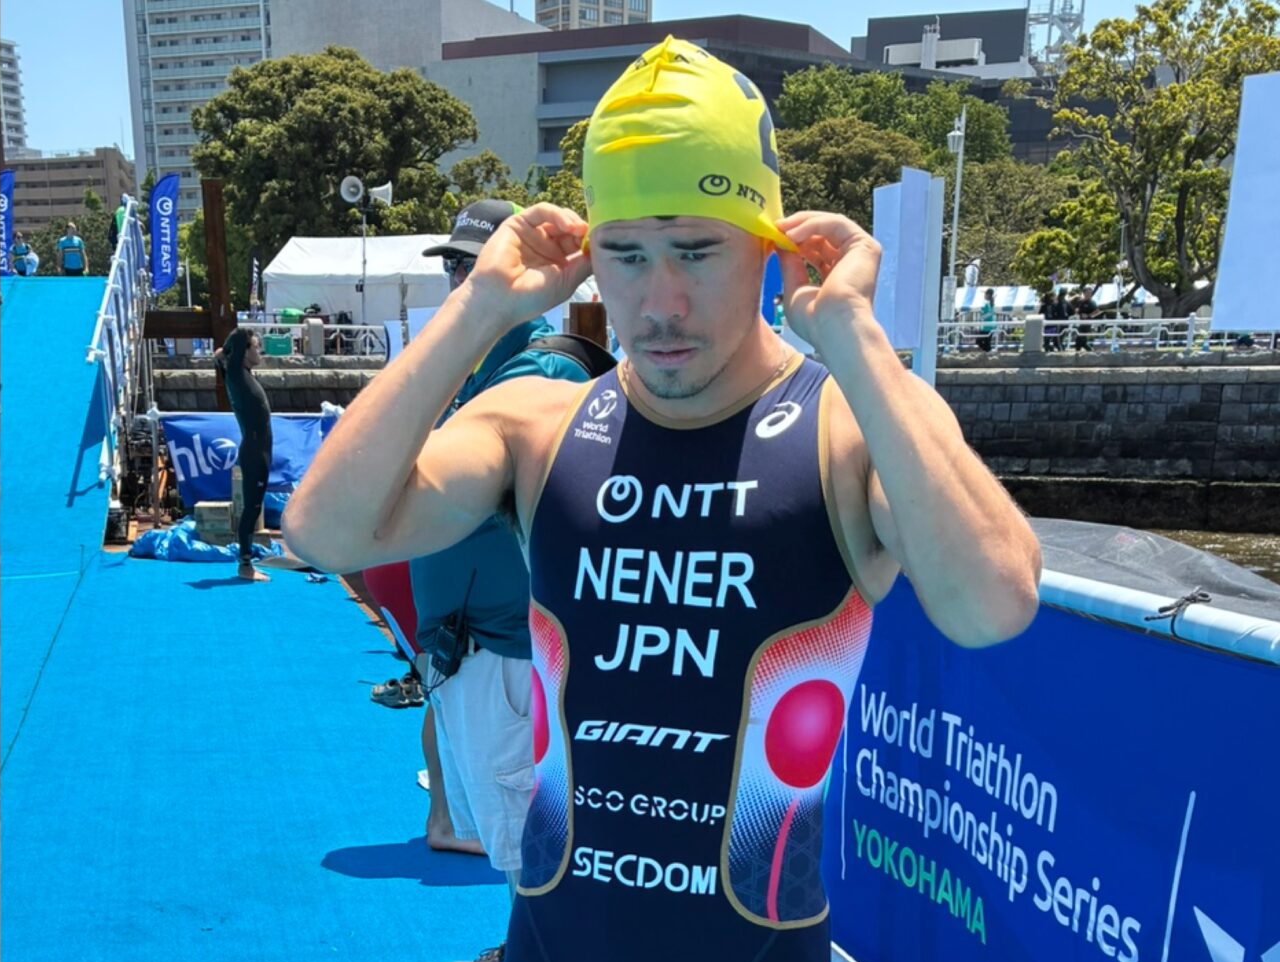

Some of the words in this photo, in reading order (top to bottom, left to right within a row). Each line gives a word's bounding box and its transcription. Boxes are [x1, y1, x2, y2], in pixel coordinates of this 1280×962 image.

[736, 183, 766, 210] NTT
[160, 217, 171, 243] NTT
[160, 244, 172, 275] EAST
[574, 428, 612, 445] Triathlon
[583, 421, 609, 433] World
[651, 480, 758, 518] NTT
[574, 547, 758, 609] NENER
[594, 623, 719, 678] JPN
[574, 720, 731, 753] GIANT
[860, 683, 934, 758] World
[942, 711, 1057, 832] Triathlon
[574, 785, 624, 812] SCO
[630, 794, 726, 825] GROUP
[855, 747, 1028, 902] Championship
[572, 846, 717, 895] SECDOM
[853, 819, 986, 946] YOKOHAMA
